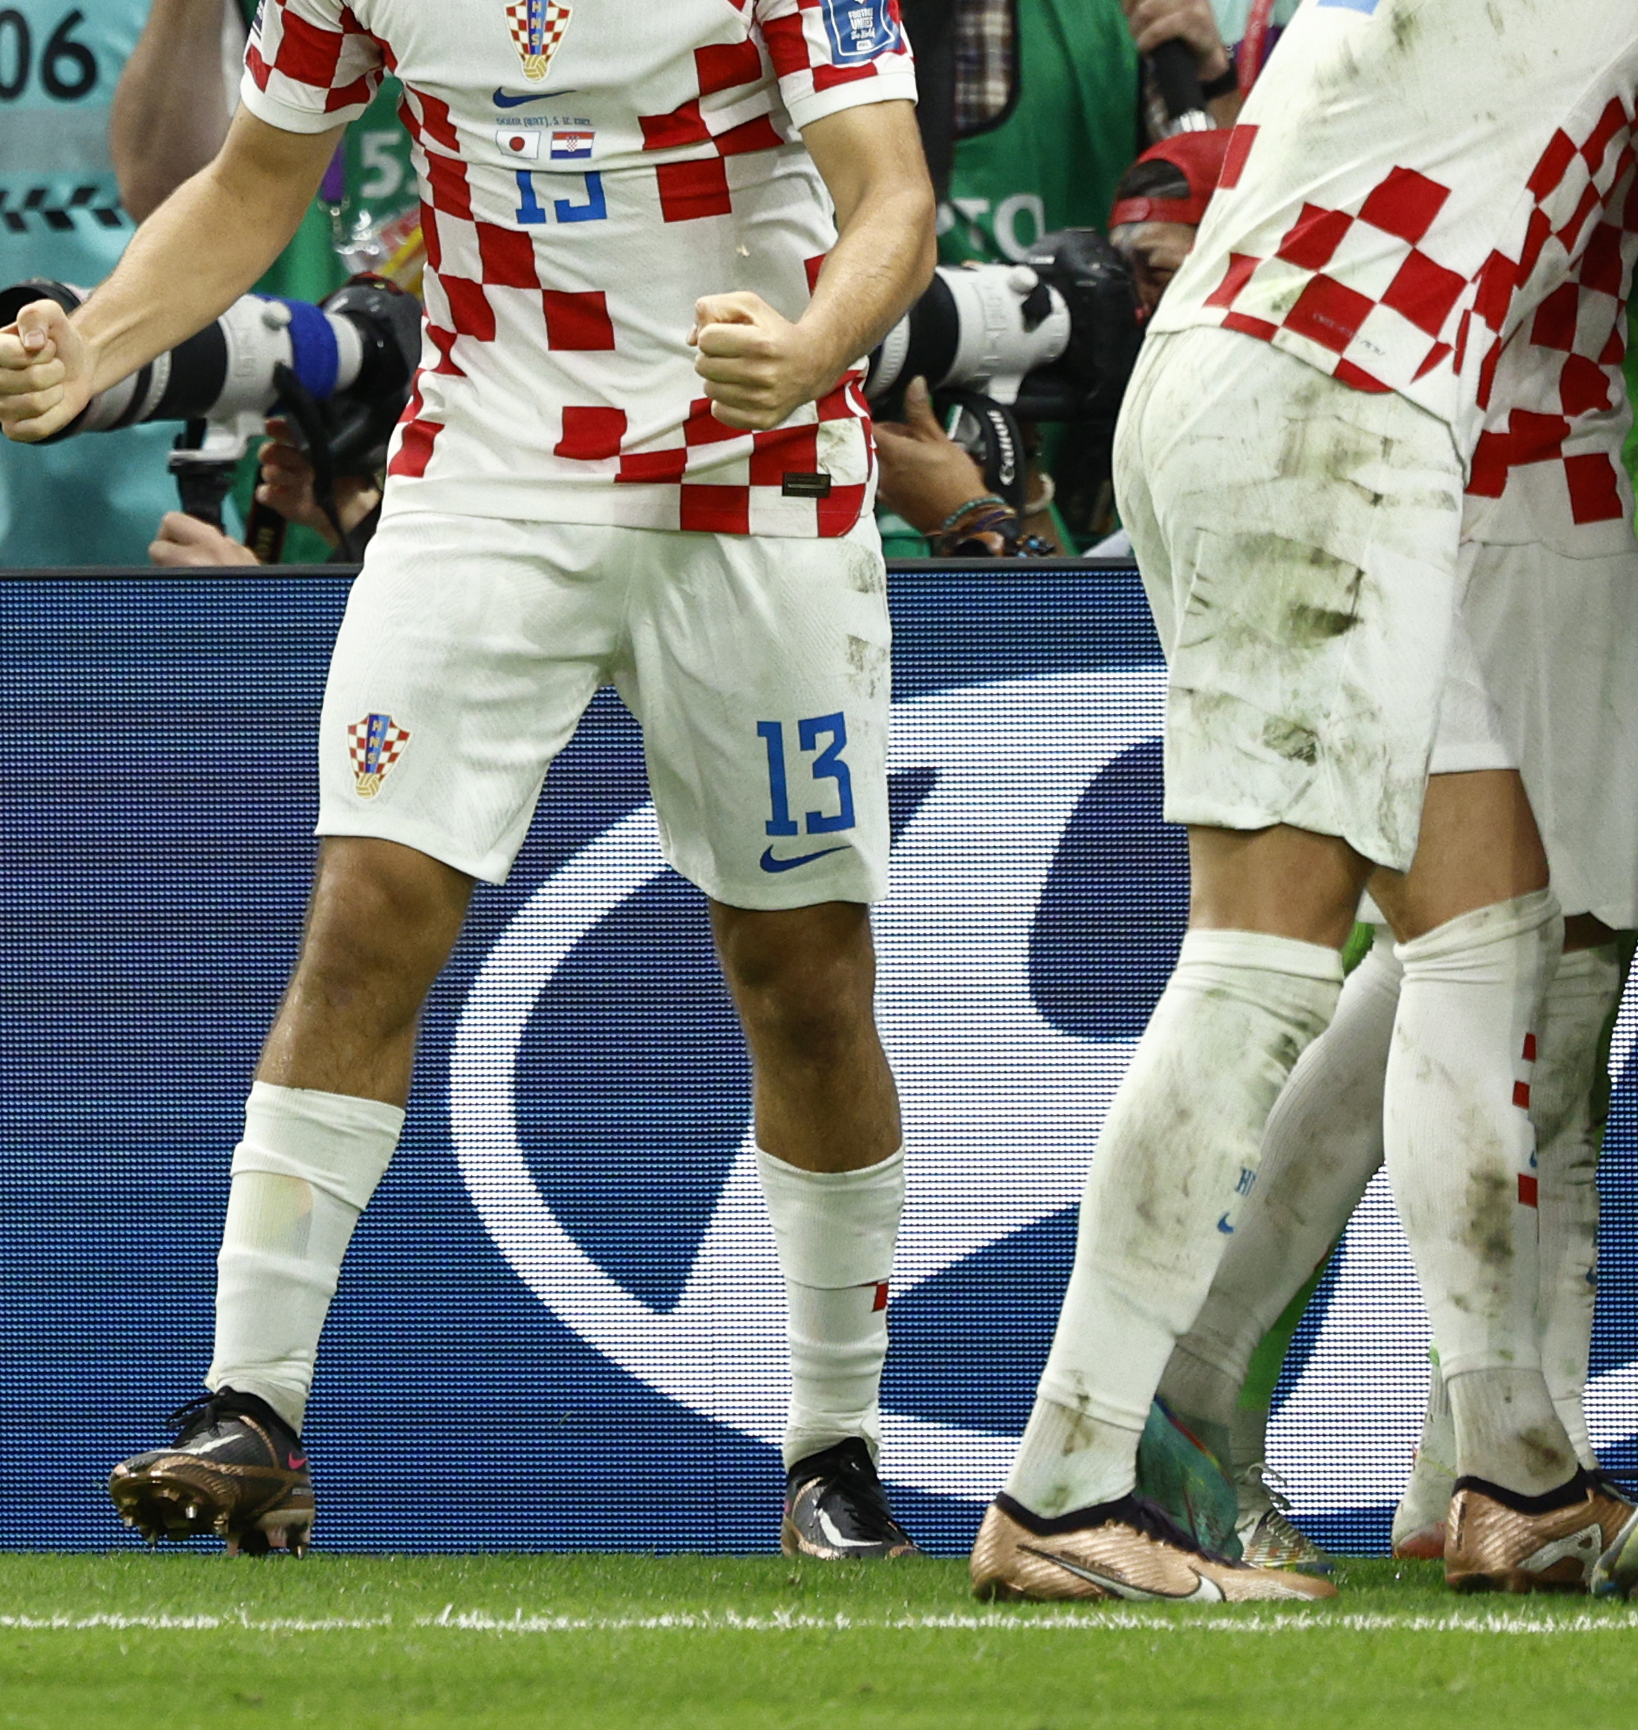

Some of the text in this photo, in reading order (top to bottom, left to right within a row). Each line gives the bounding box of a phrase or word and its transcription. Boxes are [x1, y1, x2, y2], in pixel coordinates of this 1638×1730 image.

[361, 131, 419, 199] 5
[988, 408, 1016, 487] Canon
[757, 711, 856, 836] 13
